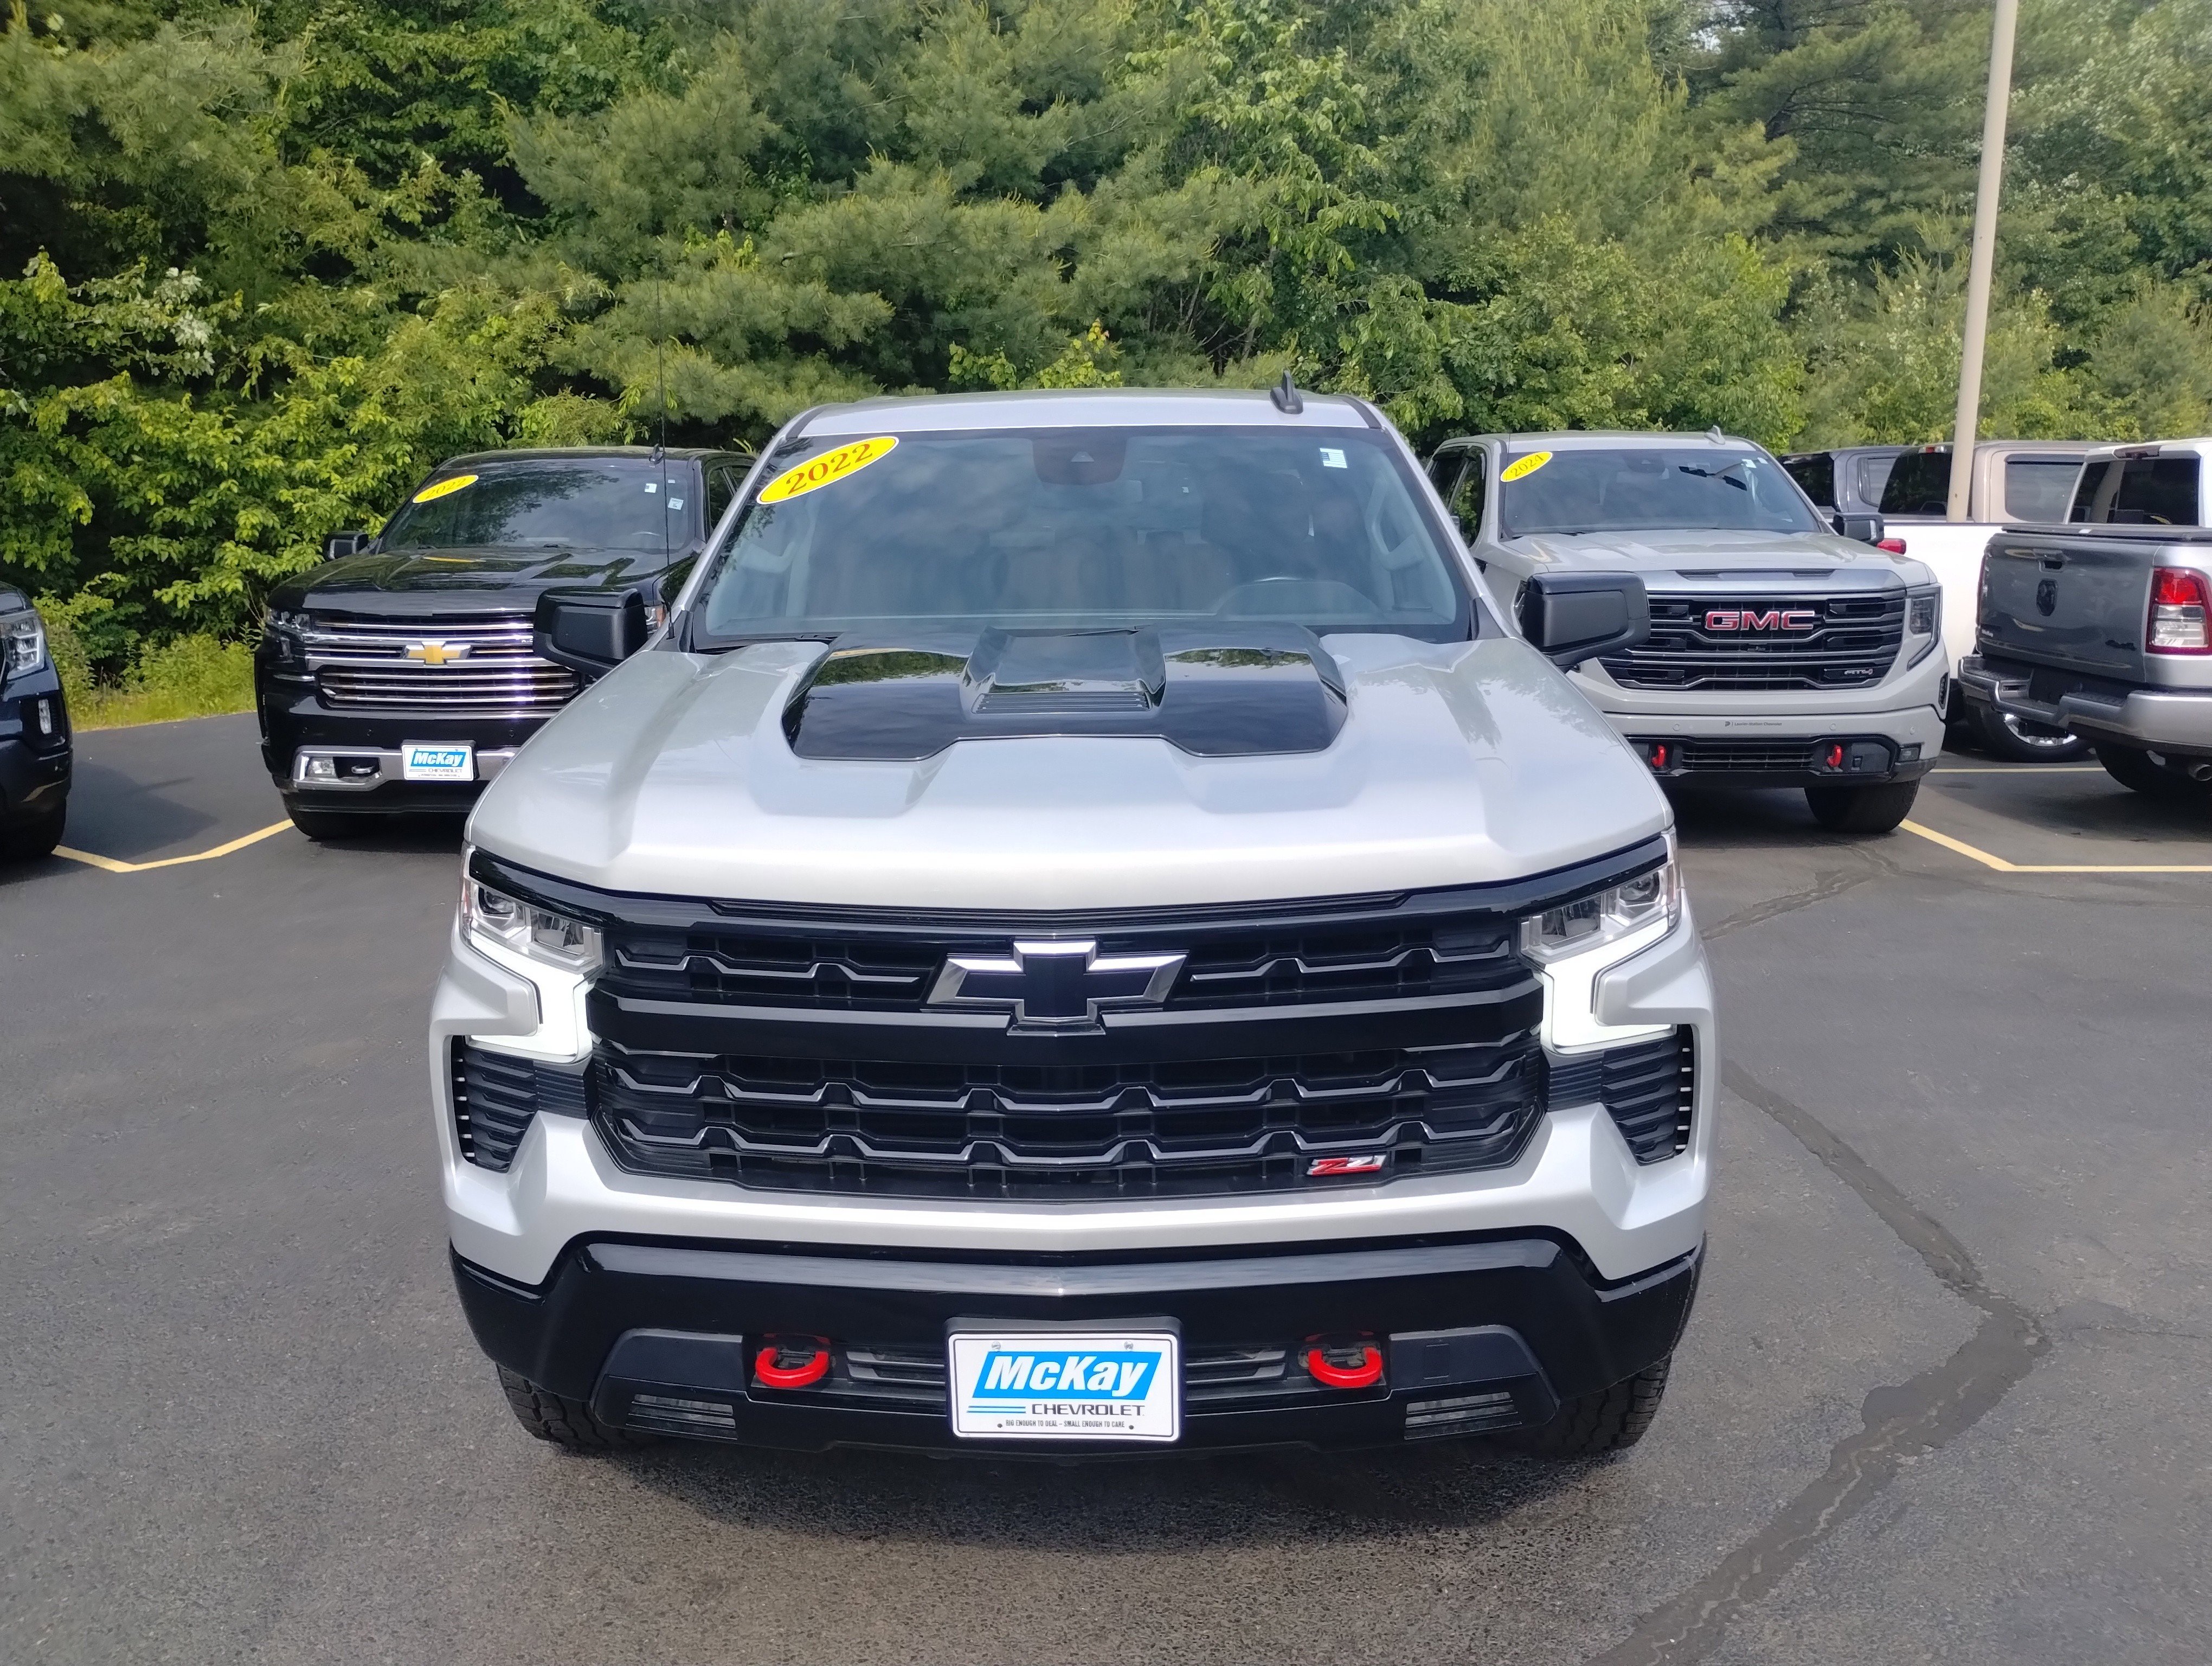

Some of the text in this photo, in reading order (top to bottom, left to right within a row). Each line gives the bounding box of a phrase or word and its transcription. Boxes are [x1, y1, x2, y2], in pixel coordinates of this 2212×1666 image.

[786, 444, 873, 495] 2022
[1706, 610, 1815, 631] GMC
[413, 752, 464, 767] McKay
[984, 1355, 1149, 1398] McKay
[1032, 1404, 1145, 1417] CHEVROLET
